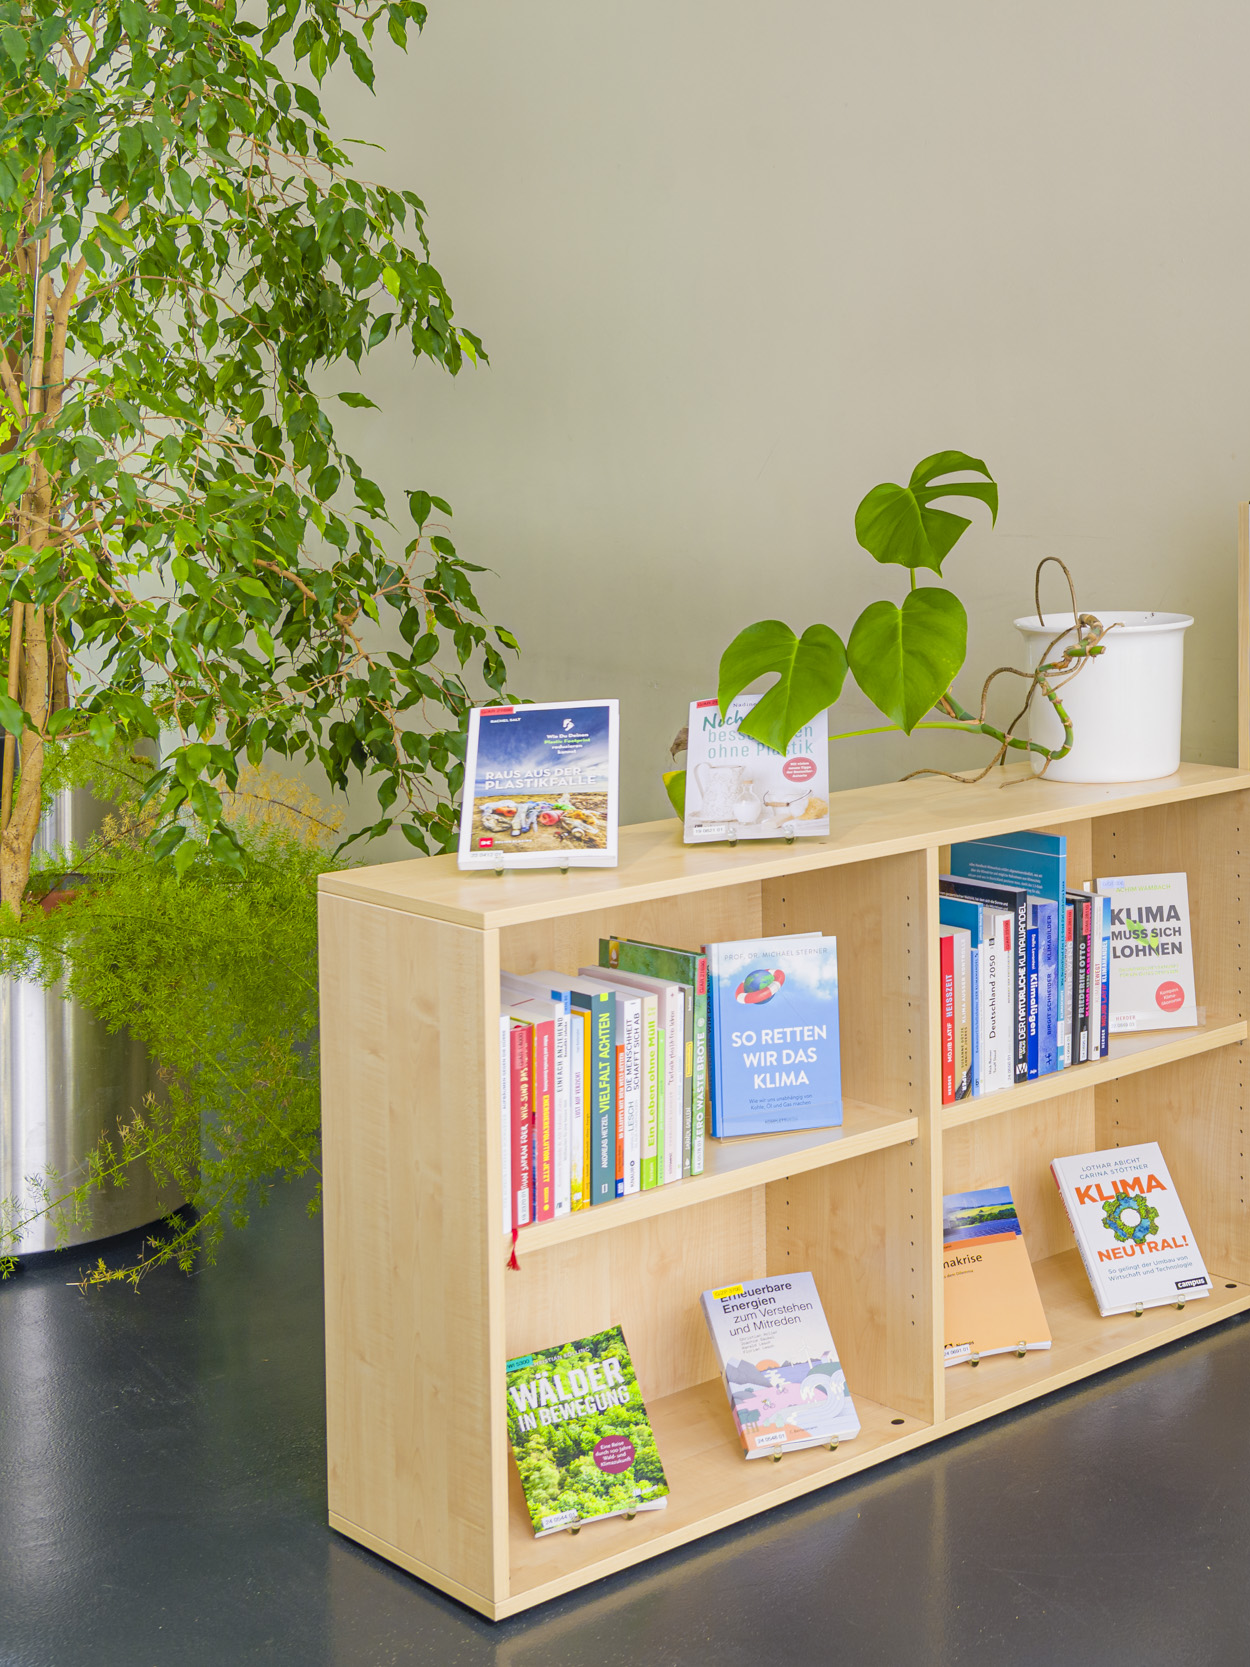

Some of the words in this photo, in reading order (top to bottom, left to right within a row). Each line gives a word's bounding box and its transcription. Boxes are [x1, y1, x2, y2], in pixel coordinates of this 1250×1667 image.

[708, 744, 750, 759] ohne
[485, 776, 596, 790] PLASTIKFALLE
[486, 771, 521, 780] RAUS
[524, 769, 550, 778] AUS
[555, 767, 581, 776] DER
[1111, 905, 1181, 926] KLIMA
[1018, 902, 1026, 967] KLIMAWANDEL
[1111, 929, 1148, 941] MUSS
[1150, 926, 1182, 938] SICH
[1112, 941, 1183, 959] LOHNEN
[1018, 967, 1026, 1021] NATÜRLICHE
[1029, 973, 1037, 1035] Klimalügen
[633, 1012, 640, 1026] AB
[988, 981, 997, 1039] Deutschland
[599, 1012, 610, 1058] ACHTEN
[647, 1020, 656, 1047] Müll
[732, 1031, 757, 1047] SO
[761, 1024, 827, 1045] RETTEN
[625, 1019, 634, 1076] MENSCHHEIT
[696, 1032, 705, 1071] BROTE
[743, 1051, 777, 1069] WIR
[782, 1047, 818, 1065] DAS
[520, 1067, 528, 1081] DAS
[633, 1050, 641, 1091] SCHAFFT
[648, 1050, 656, 1085] ohne
[600, 1059, 611, 1113] VIELFALT
[753, 1070, 809, 1089] KLIMA
[520, 1083, 529, 1101] SIND
[696, 1073, 705, 1110] WASTE
[521, 1103, 530, 1120] WIR
[627, 1101, 635, 1132] LESCH
[647, 1087, 656, 1125] Leben
[648, 1126, 656, 1147] Ein
[1079, 1170, 1108, 1180] CARINA
[1110, 1163, 1148, 1175] STÖTTNER
[1082, 1162, 1112, 1172] LOTHAR
[1114, 1157, 1140, 1167] ABICHT
[1075, 1174, 1168, 1205] KLIMA
[1097, 1235, 1189, 1263] NEUTRAL!
[1177, 1278, 1205, 1288] campus
[722, 1295, 776, 1314] Energien
[733, 1312, 757, 1324] zum
[759, 1301, 813, 1318] Verstehen
[730, 1325, 750, 1337] und
[753, 1315, 801, 1332] Mitreden
[509, 1356, 625, 1414] WÄLDER
[518, 1413, 537, 1433] IN
[538, 1385, 631, 1427] BEWEGUNG
